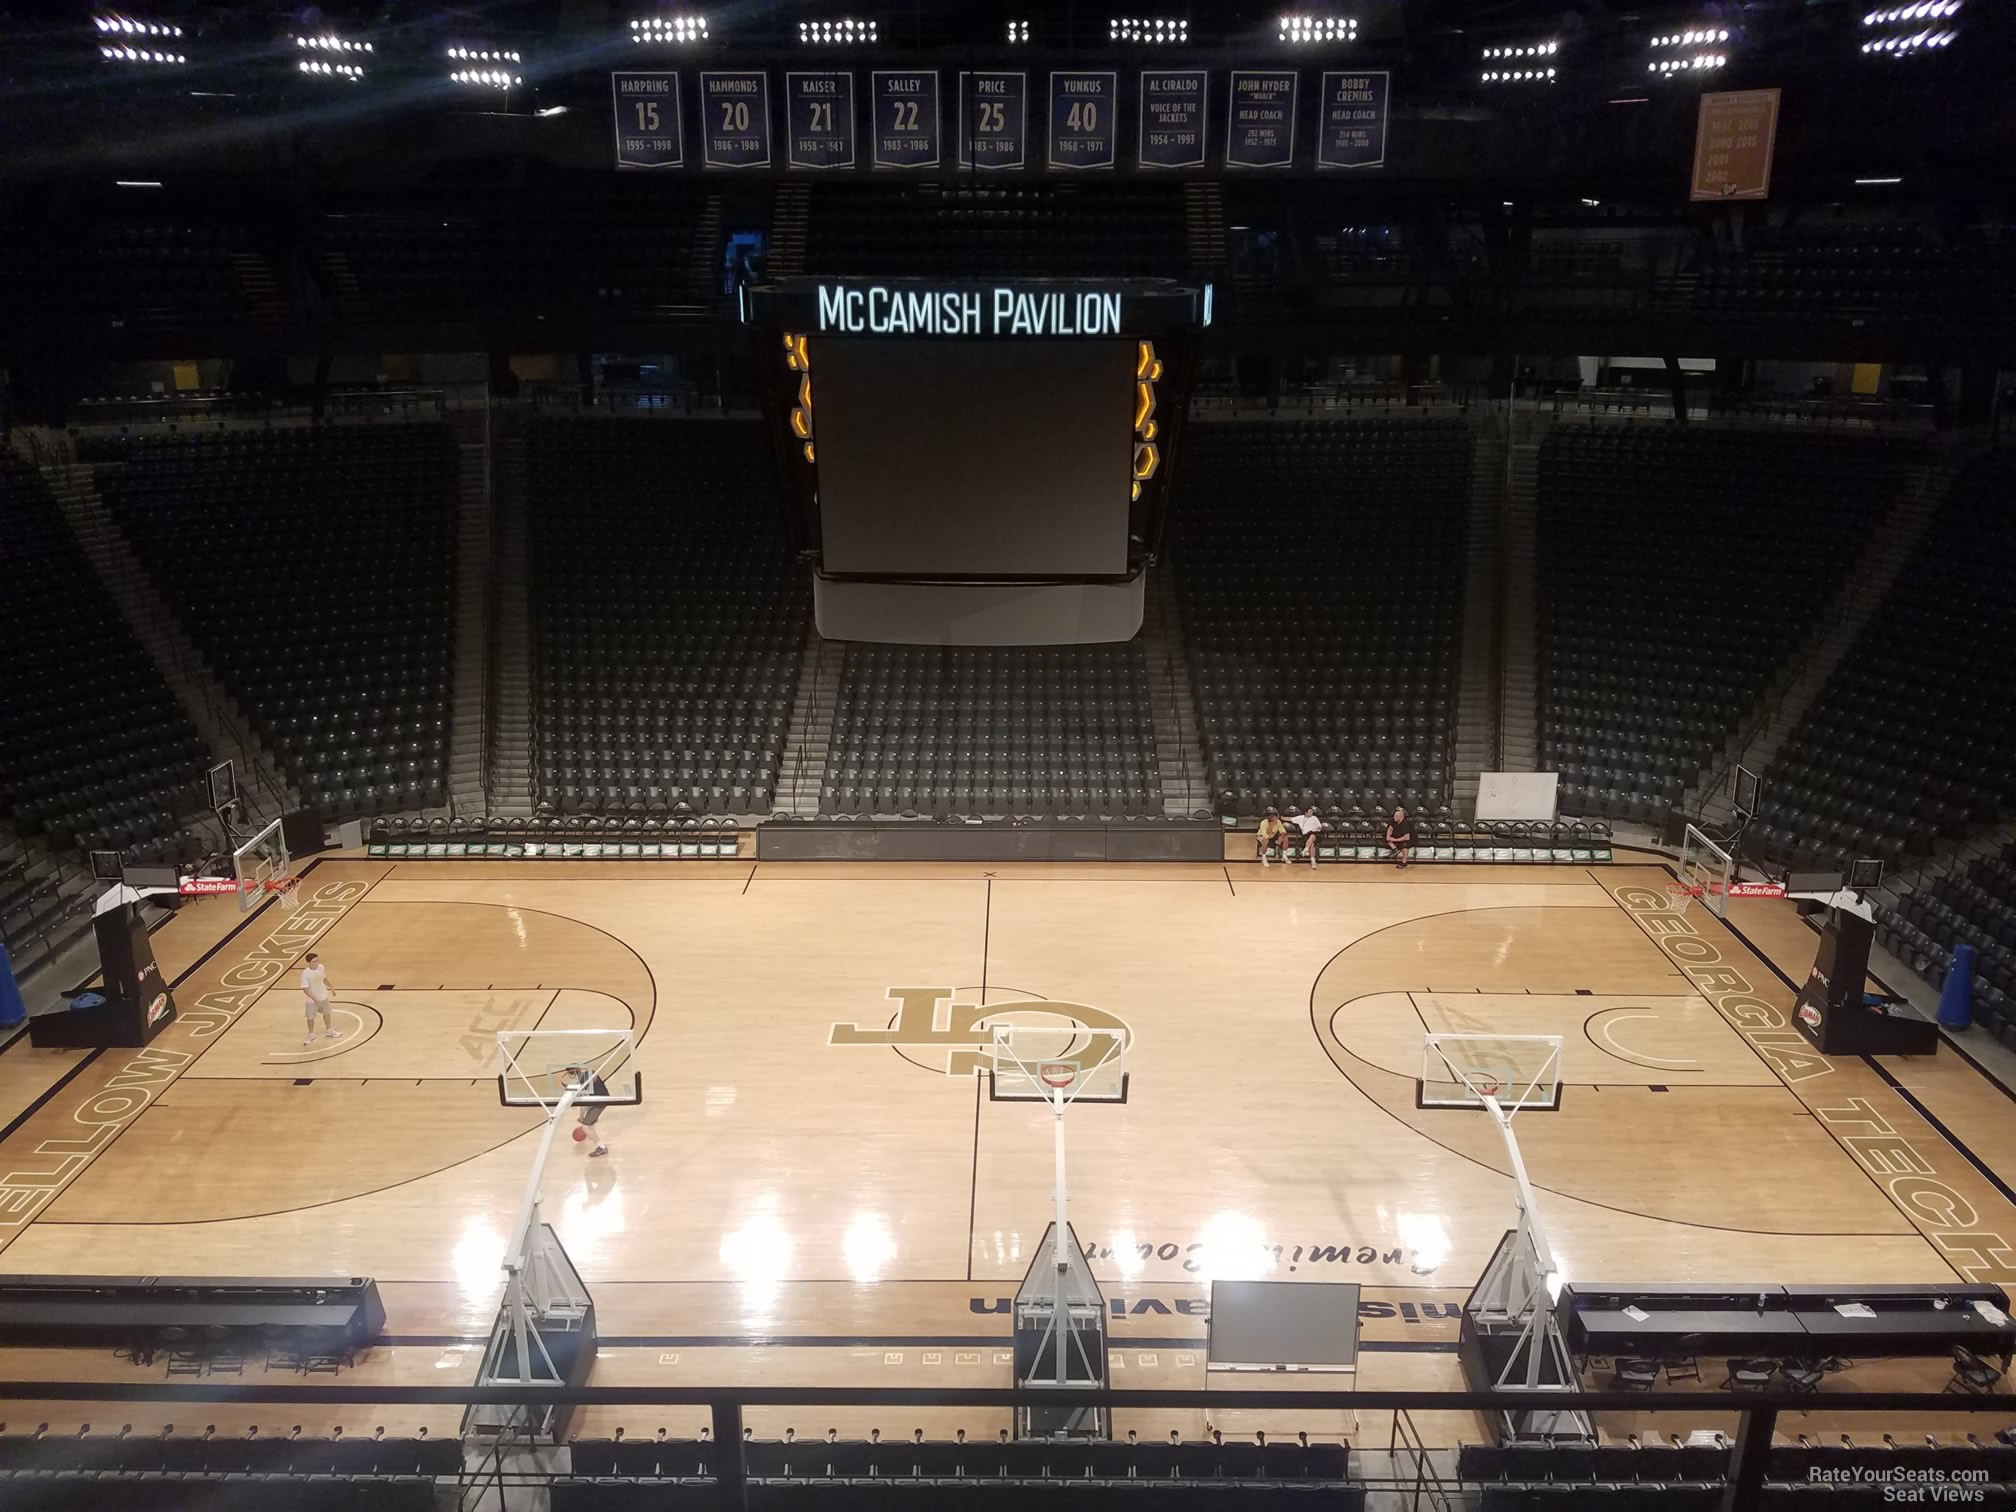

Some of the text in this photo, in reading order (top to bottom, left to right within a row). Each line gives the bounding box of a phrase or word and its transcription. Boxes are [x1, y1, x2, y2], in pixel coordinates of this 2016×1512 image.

[620, 80, 669, 92] HARPRING
[709, 80, 758, 92] HAMMONDS
[802, 80, 836, 93] KAISER
[888, 80, 920, 92] SALLEY
[978, 80, 1005, 93] PRICE
[1064, 80, 1102, 92] YUNKUS
[1150, 80, 1198, 91] AL CIRALDO
[1237, 80, 1290, 92] JOHN HYDER
[1341, 78, 1370, 90] BOBBY
[1336, 90, 1373, 102] CREMINS
[1150, 103, 1197, 112] VOICE OF THE
[636, 102, 660, 130] 15
[722, 102, 750, 131] 20
[810, 102, 832, 132] 21
[894, 102, 918, 130] 22
[979, 102, 1005, 132] 25
[1067, 102, 1097, 132] 40
[1158, 113, 1188, 122] JACKETS
[1239, 110, 1283, 120] HEAD COACH
[1332, 110, 1376, 120] HEAD COACH
[626, 140, 644, 150] 1995
[653, 140, 672, 150] 1998
[713, 140, 732, 150] 1986
[741, 140, 760, 150] 1989
[910, 140, 928, 150] 1986
[1150, 134, 1168, 144] 1954
[1177, 134, 1195, 144] 1993
[798, 140, 817, 152] 1958
[996, 141, 1014, 152] 1986
[1059, 140, 1078, 152] 1968
[1086, 140, 1104, 152] 1971
[144, 960, 157, 976] PNC
[1614, 885, 1836, 1083] GEORGIA
[1817, 971, 1831, 988] PNC
[0, 880, 370, 1240] ELLOW JACKETS
